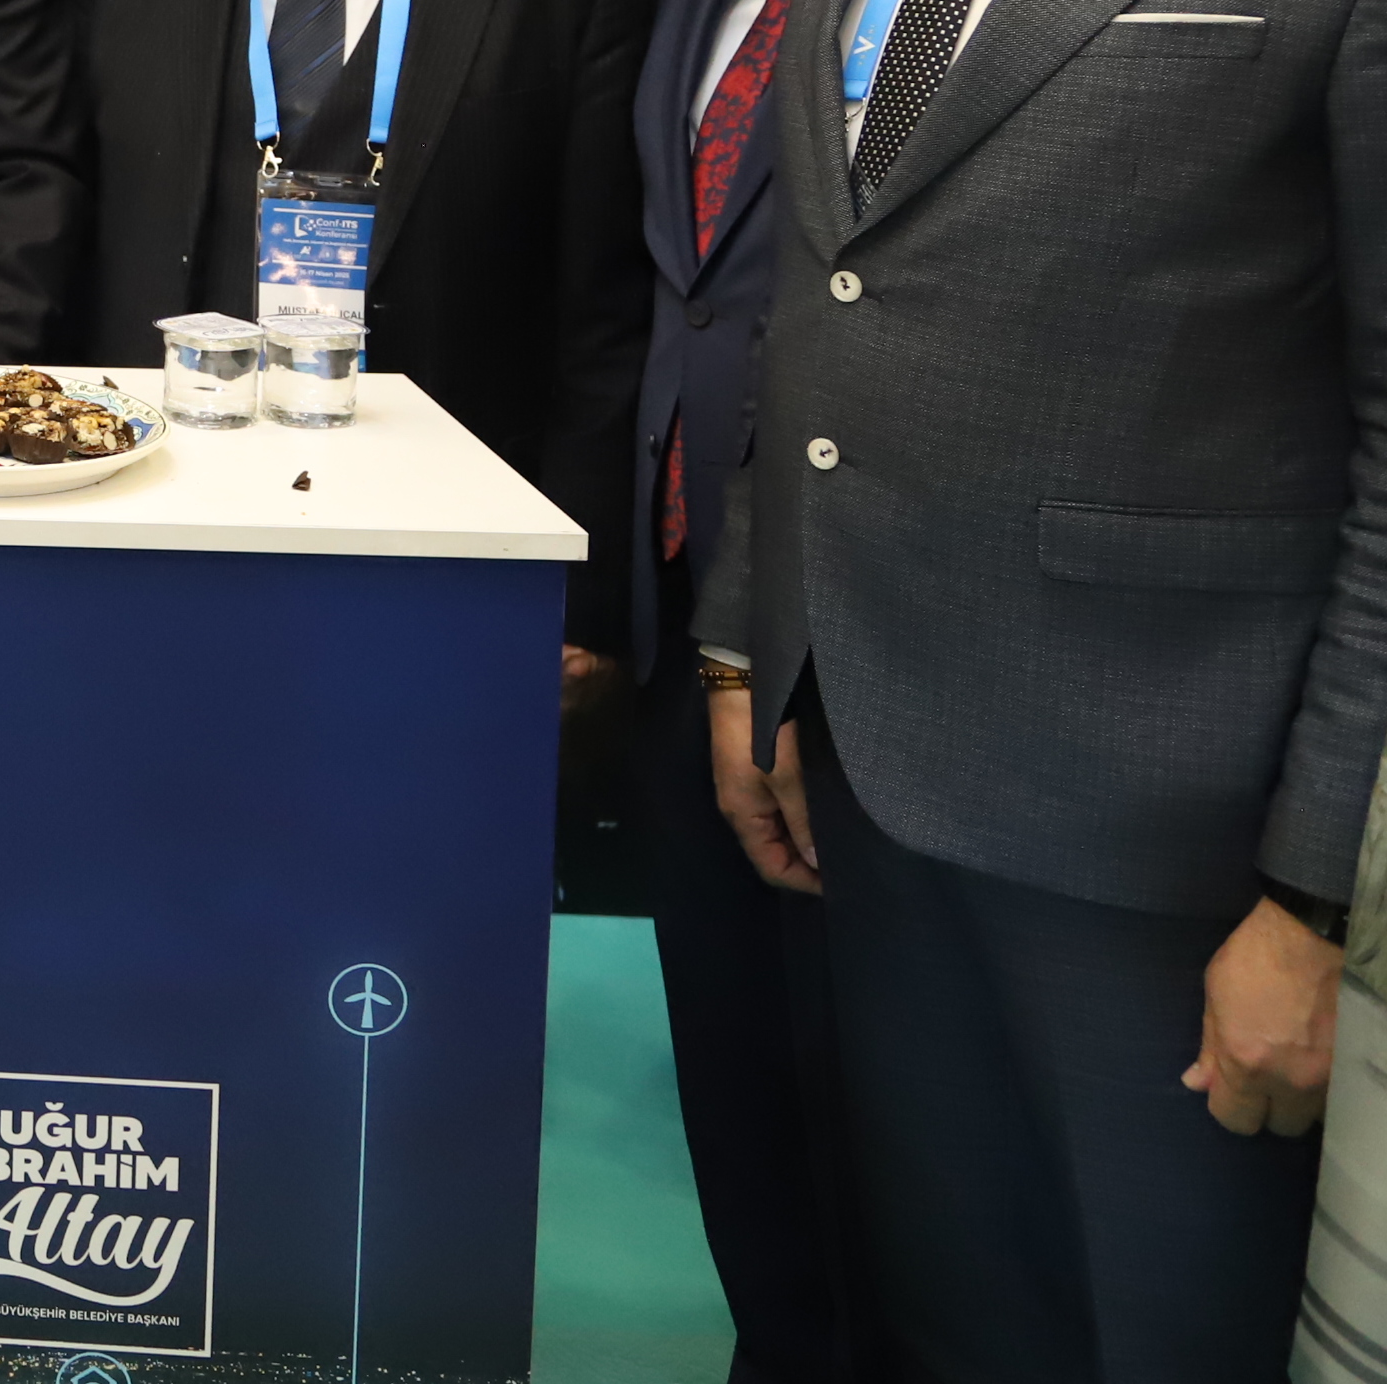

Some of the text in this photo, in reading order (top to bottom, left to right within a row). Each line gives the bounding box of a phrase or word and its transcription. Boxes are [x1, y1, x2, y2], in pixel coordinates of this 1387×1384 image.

[316, 217, 359, 229] Conf-ITS
[0, 1101, 144, 1152] UĞUR
[69, 1308, 125, 1323] BELEDİYE
[127, 1313, 181, 1327] BAŞKANI
